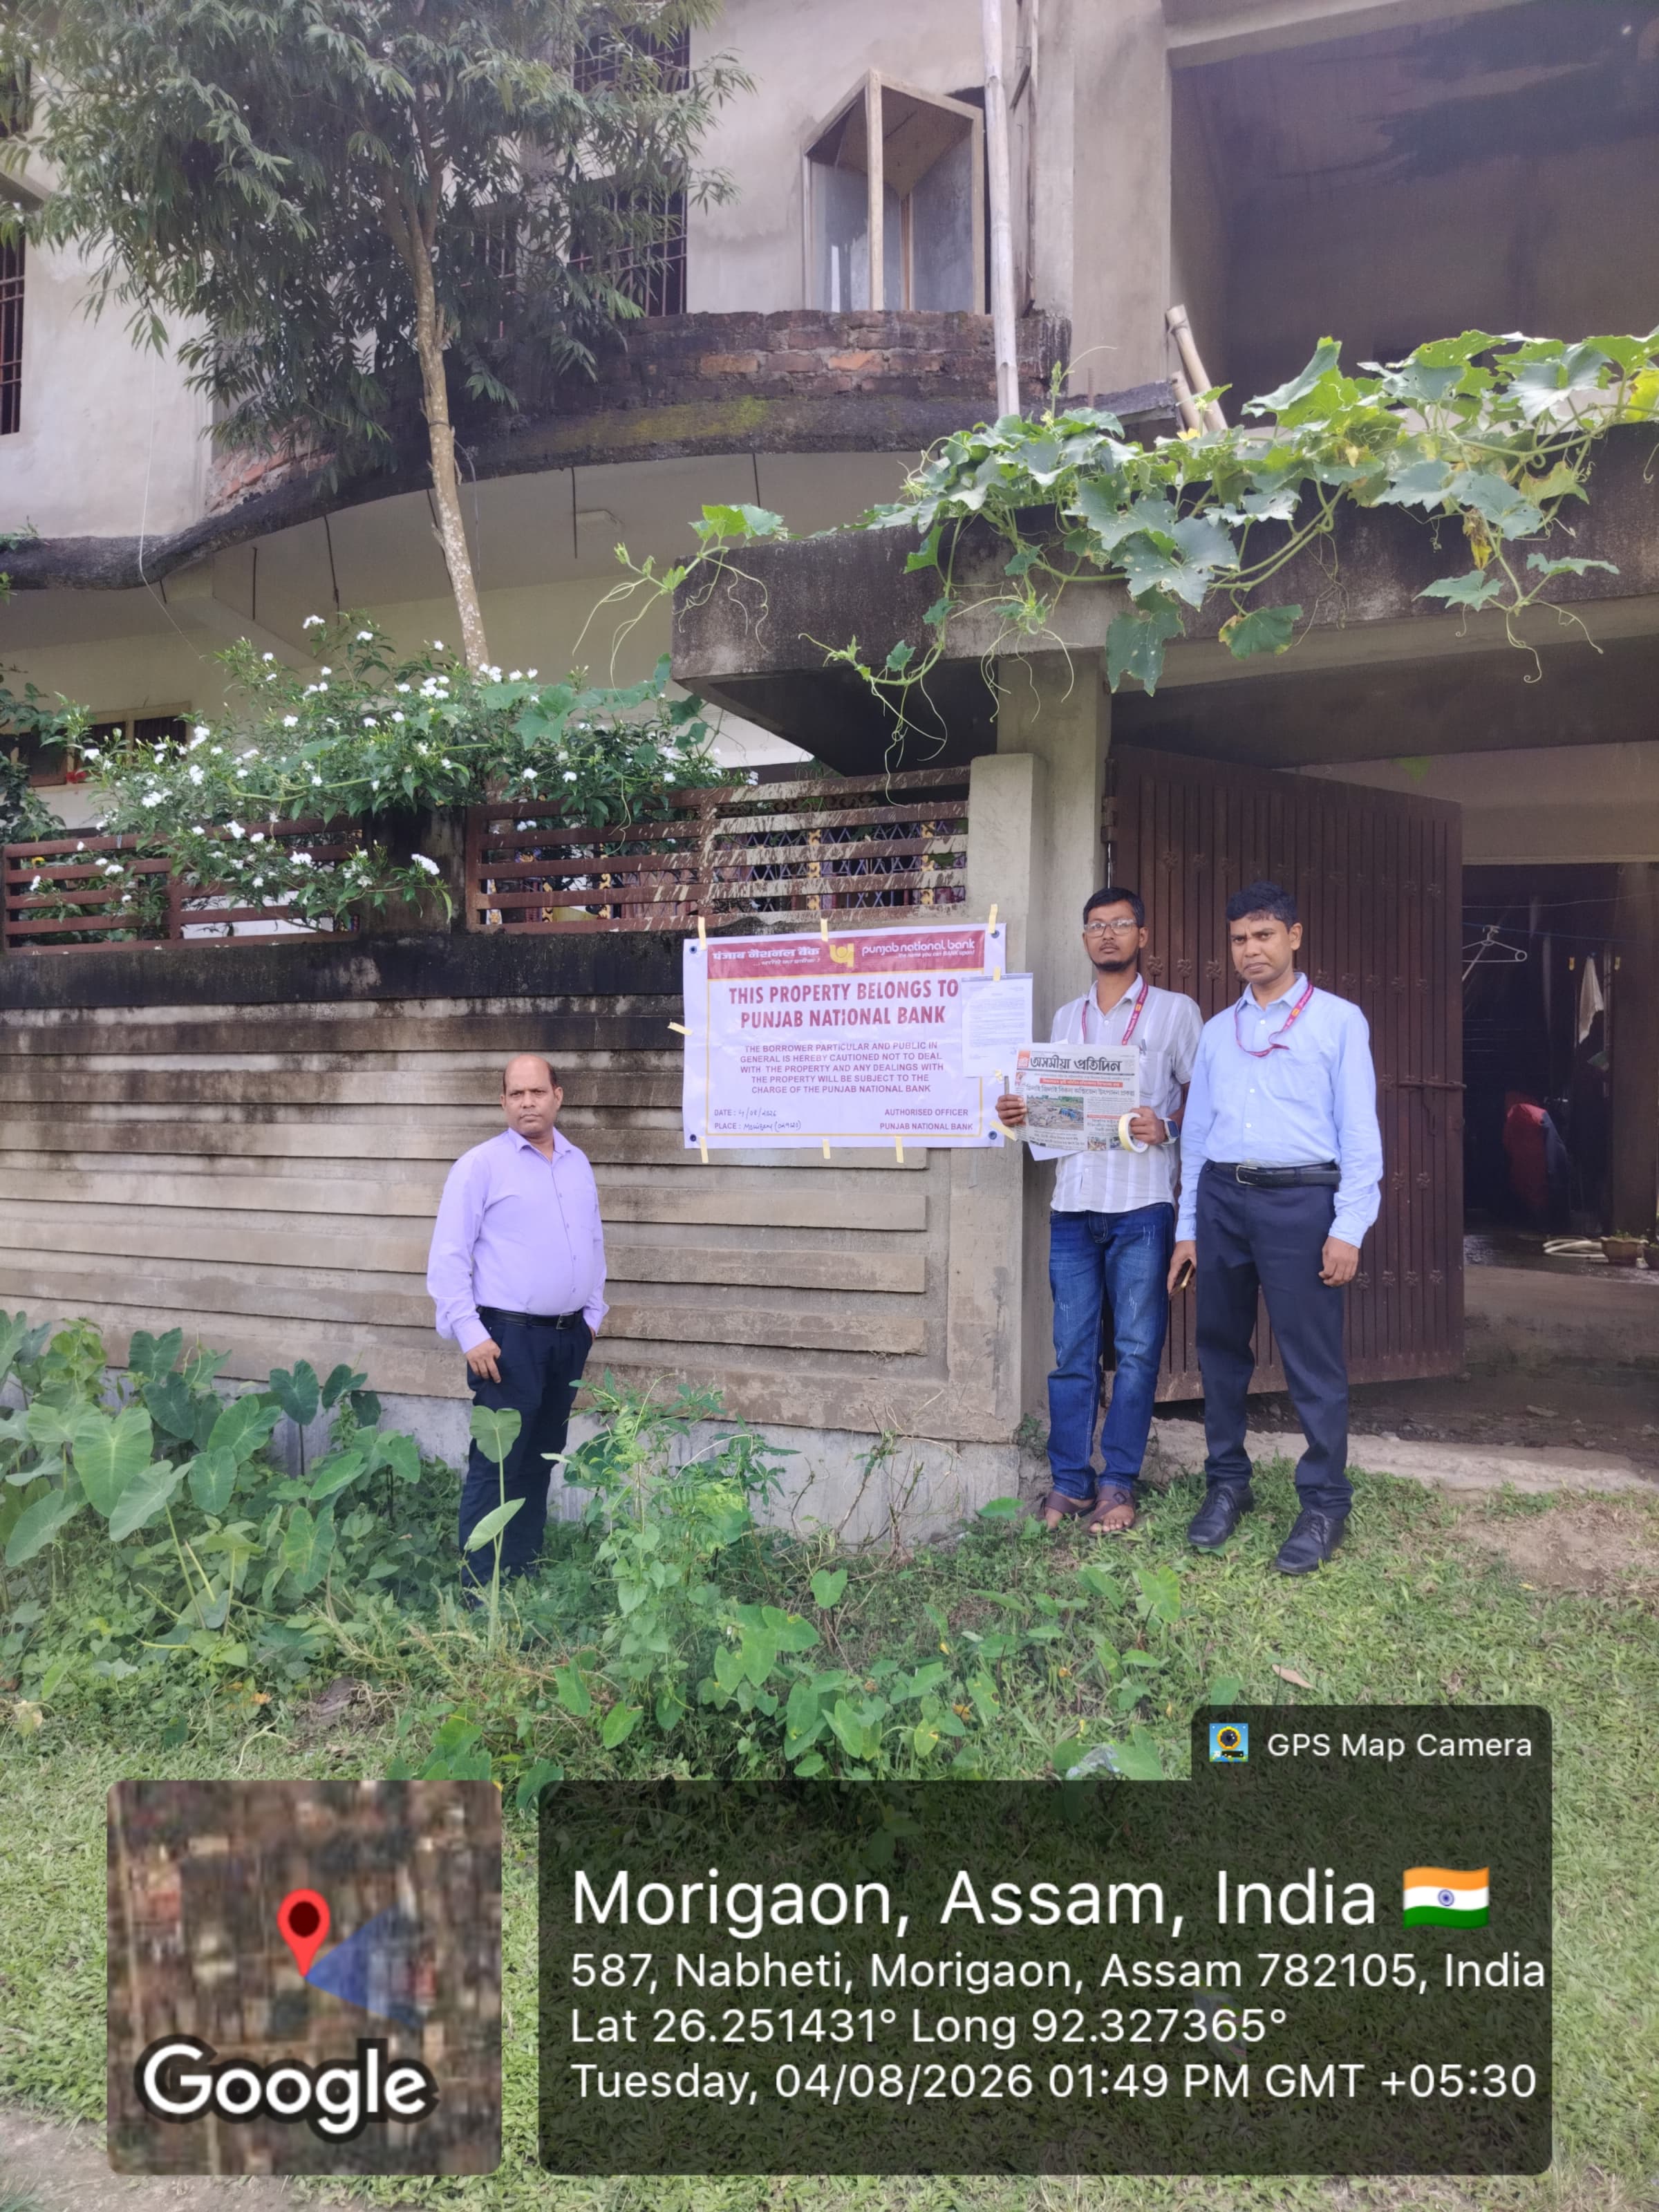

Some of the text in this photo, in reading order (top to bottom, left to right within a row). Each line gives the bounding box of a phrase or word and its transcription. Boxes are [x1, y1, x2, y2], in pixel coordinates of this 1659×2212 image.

[713, 951, 746, 960] पंजाब
[798, 946, 821, 957] बैंक
[862, 939, 975, 957] punjab national bank
[729, 979, 959, 1004] THIS PROPERTY BELONGS TO
[740, 1005, 946, 1029] PUNJAB NATIONAL BANK
[816, 1043, 870, 1051] PARTICULAR
[793, 1054, 827, 1062] HEREBY
[830, 1053, 879, 1062] CAUTIONED
[917, 1052, 943, 1060] DEAL
[785, 1065, 830, 1073] PROPERTY
[873, 1063, 919, 1071] DEALINGS
[769, 1075, 816, 1083] PROPERTY
[911, 1074, 930, 1082] THE
[859, 1085, 903, 1093] NATIONAL
[885, 1108, 968, 1116] AUTHORISED OFFICER
